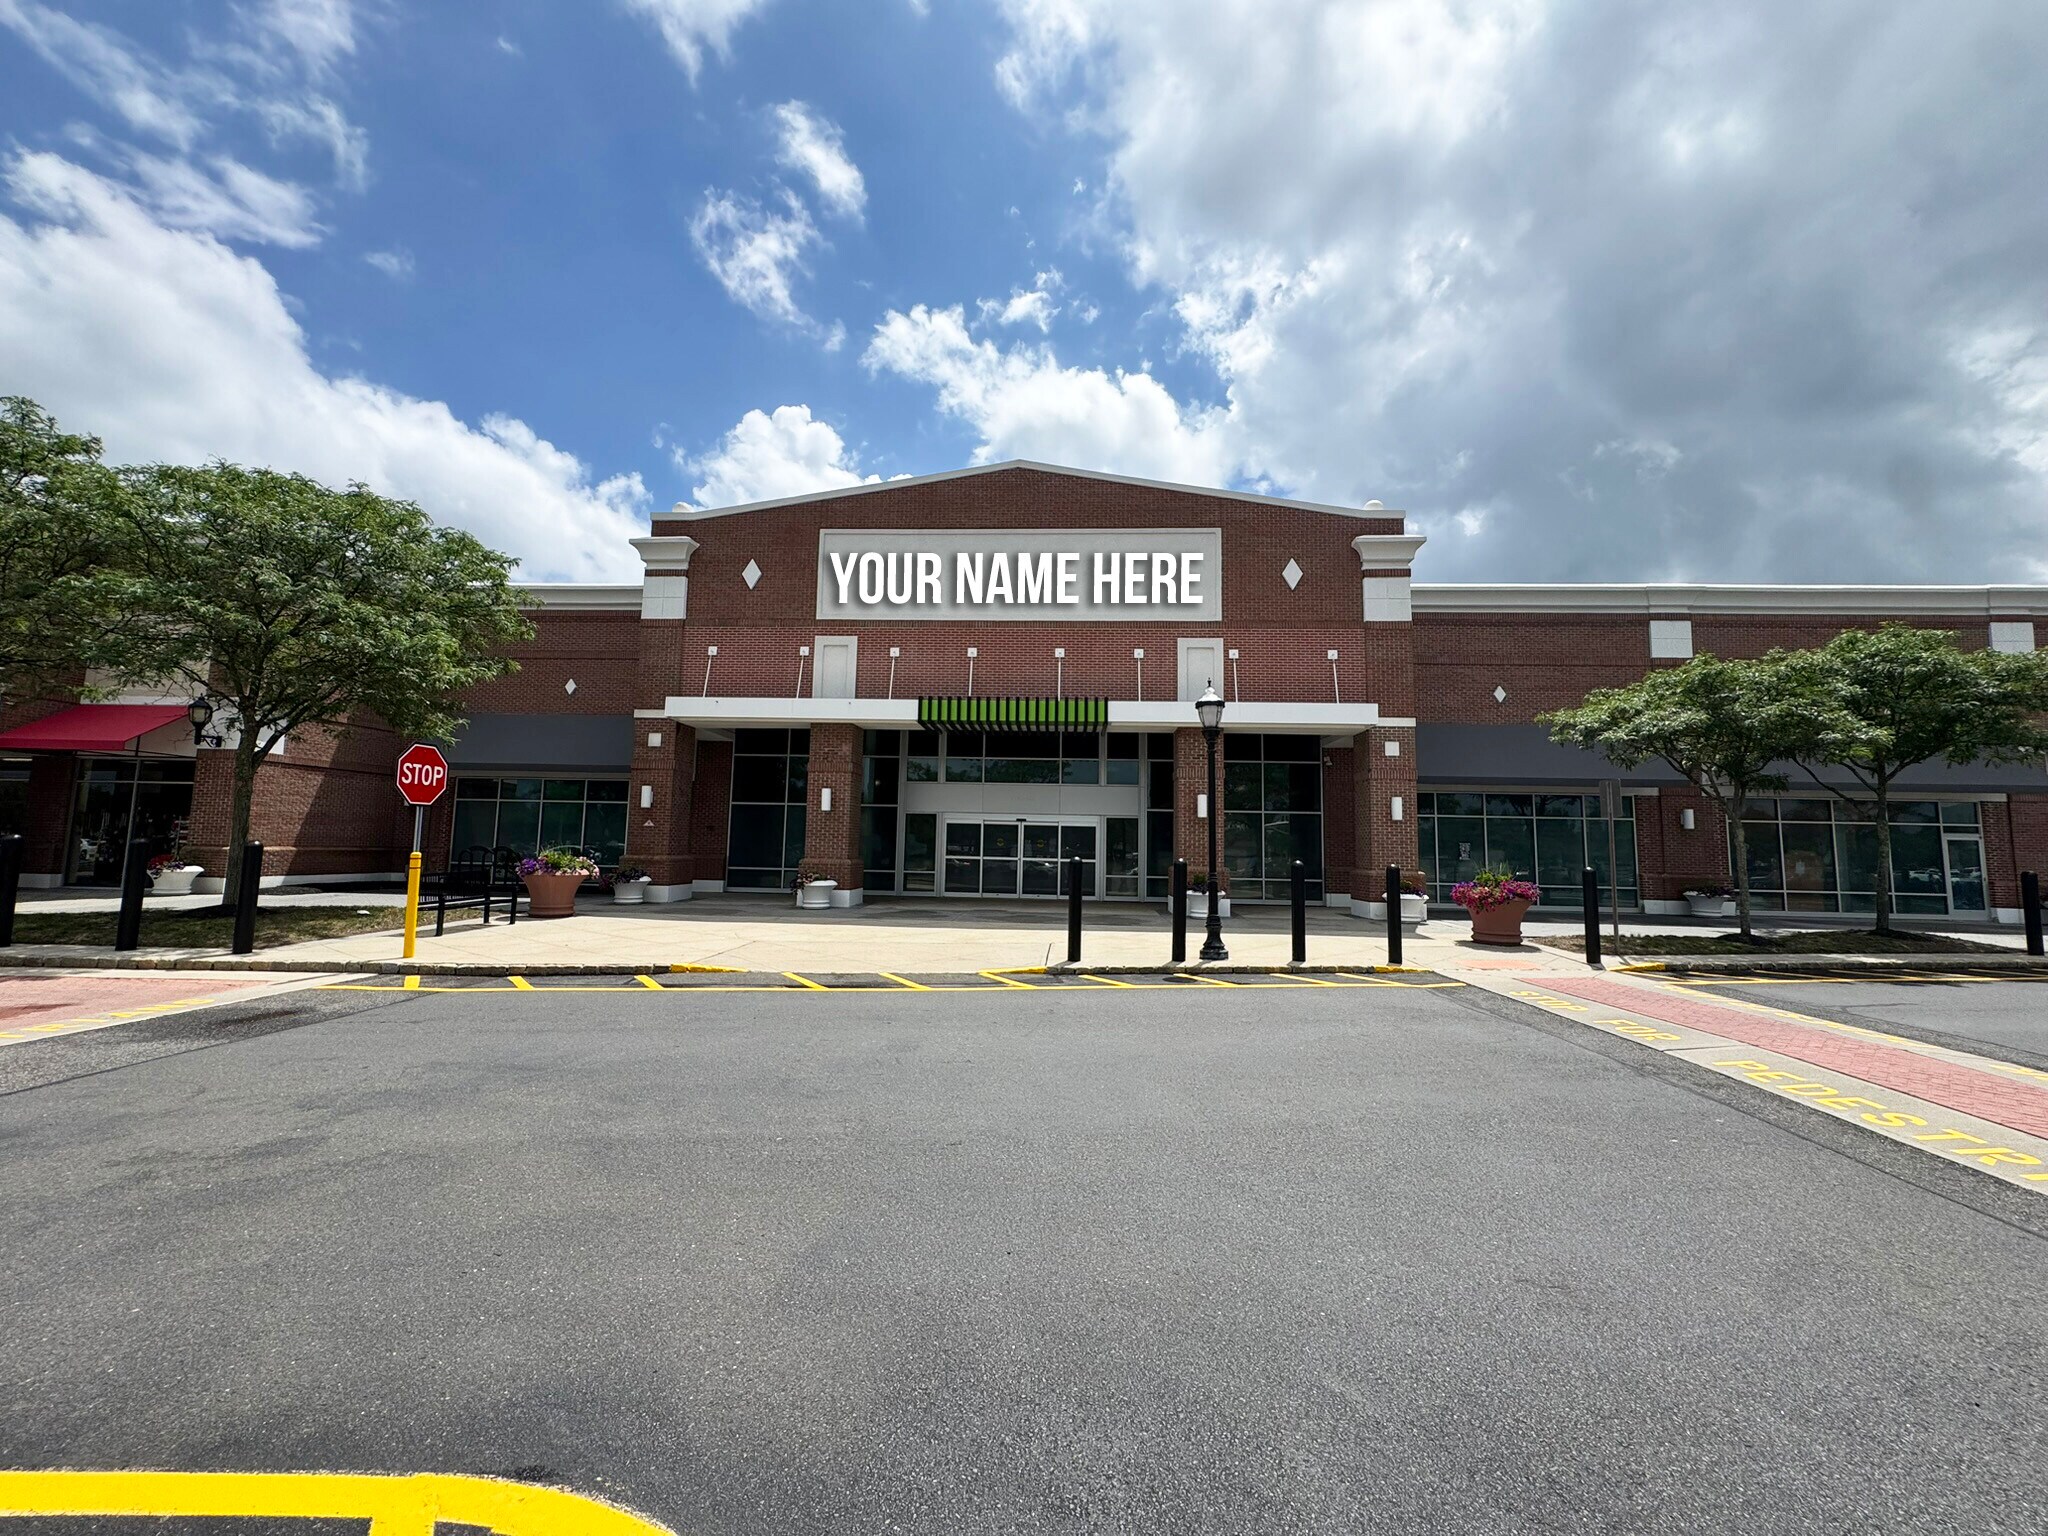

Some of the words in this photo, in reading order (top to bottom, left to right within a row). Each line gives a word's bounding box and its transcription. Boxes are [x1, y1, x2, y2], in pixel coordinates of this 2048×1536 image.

[830, 552, 942, 604] YOUR
[956, 552, 1080, 604] NAME
[1093, 552, 1204, 604] HERE
[401, 762, 444, 787] STOP
[1509, 990, 1588, 1012] STOP
[1594, 1018, 1681, 1042] FOR
